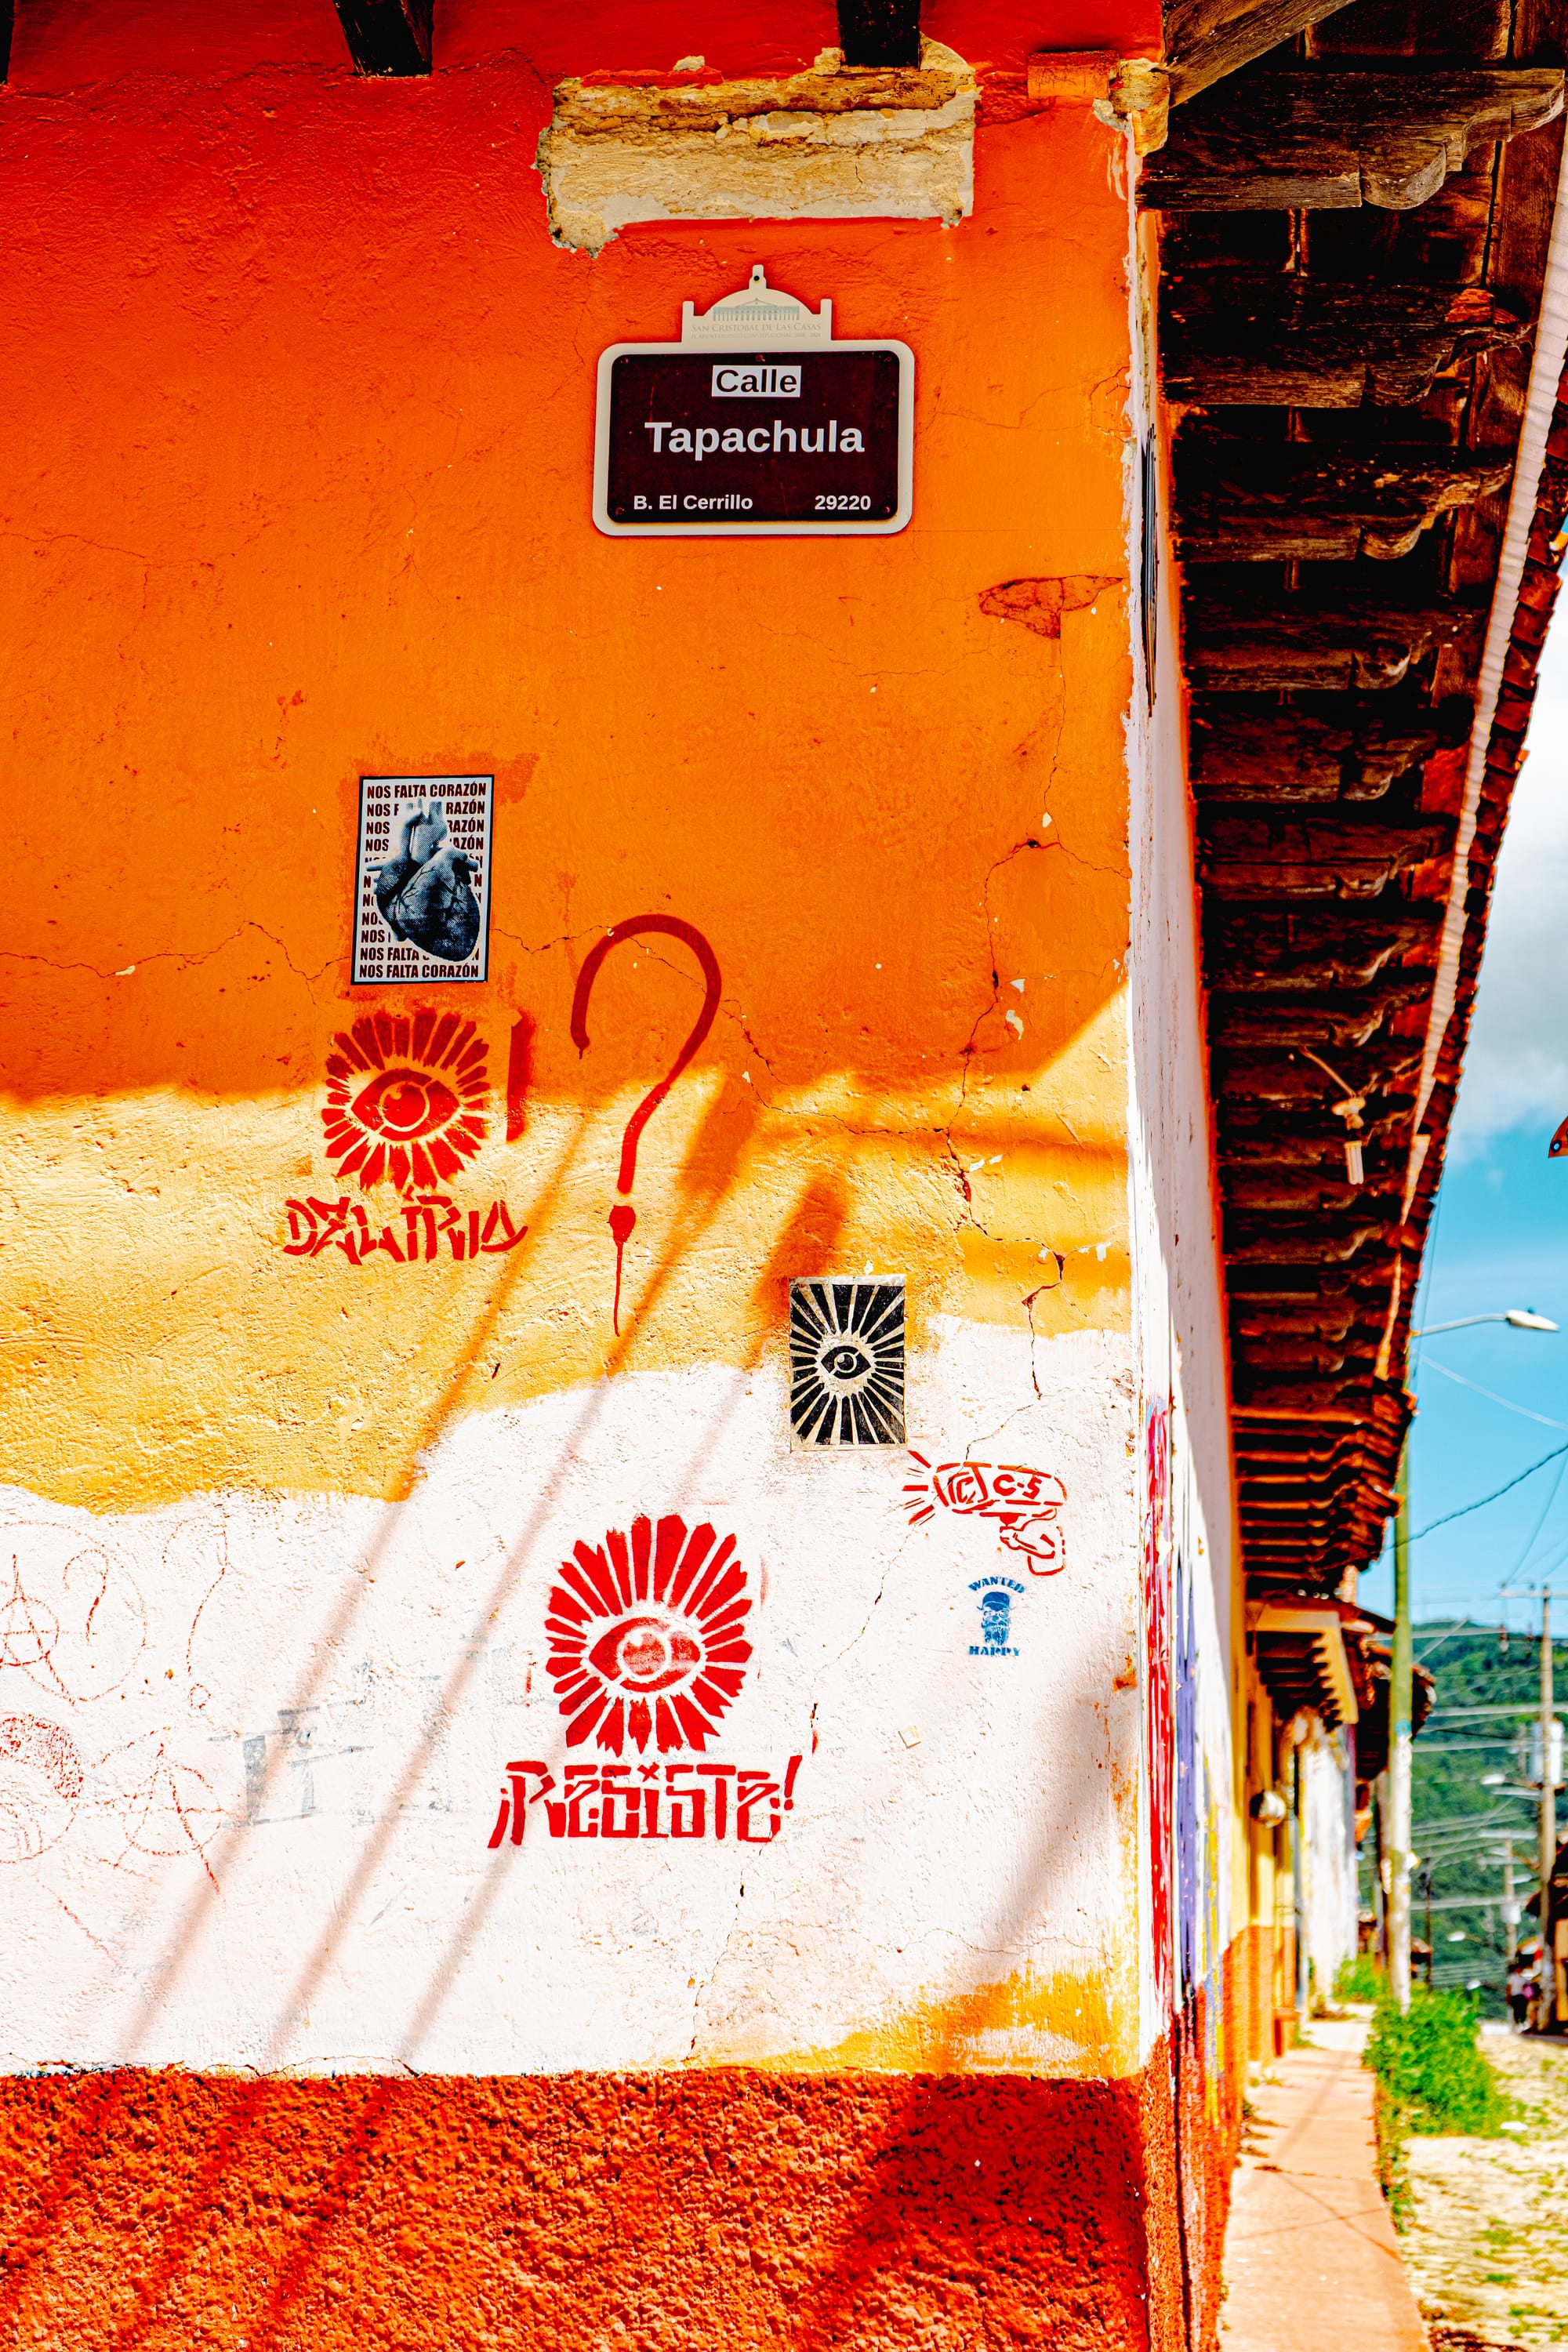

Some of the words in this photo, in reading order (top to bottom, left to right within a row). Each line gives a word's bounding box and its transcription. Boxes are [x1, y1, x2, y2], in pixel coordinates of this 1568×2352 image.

[716, 368, 798, 394] Calle
[644, 420, 866, 461] Tapachula
[633, 495, 652, 510] B.
[659, 495, 677, 510] El
[683, 494, 753, 510] Cerrillo
[815, 495, 872, 510] 29220
[367, 786, 391, 799] NOS
[394, 784, 426, 798] FALTA
[430, 781, 486, 797] CORAZÓN
[366, 804, 390, 816] NOS
[445, 799, 485, 815] RAZÓN
[366, 822, 390, 834] NOS
[365, 839, 389, 851] NOS
[361, 912, 383, 925] NO
[361, 929, 385, 943] NOS
[360, 947, 384, 960] NOS
[387, 947, 419, 960] FALTA
[359, 964, 383, 978] NOS
[386, 964, 419, 978] FALTA
[422, 963, 479, 978] CORAZÓN
[967, 1575, 1025, 1594] WANTED
[969, 1645, 1020, 1657] HAPPY
